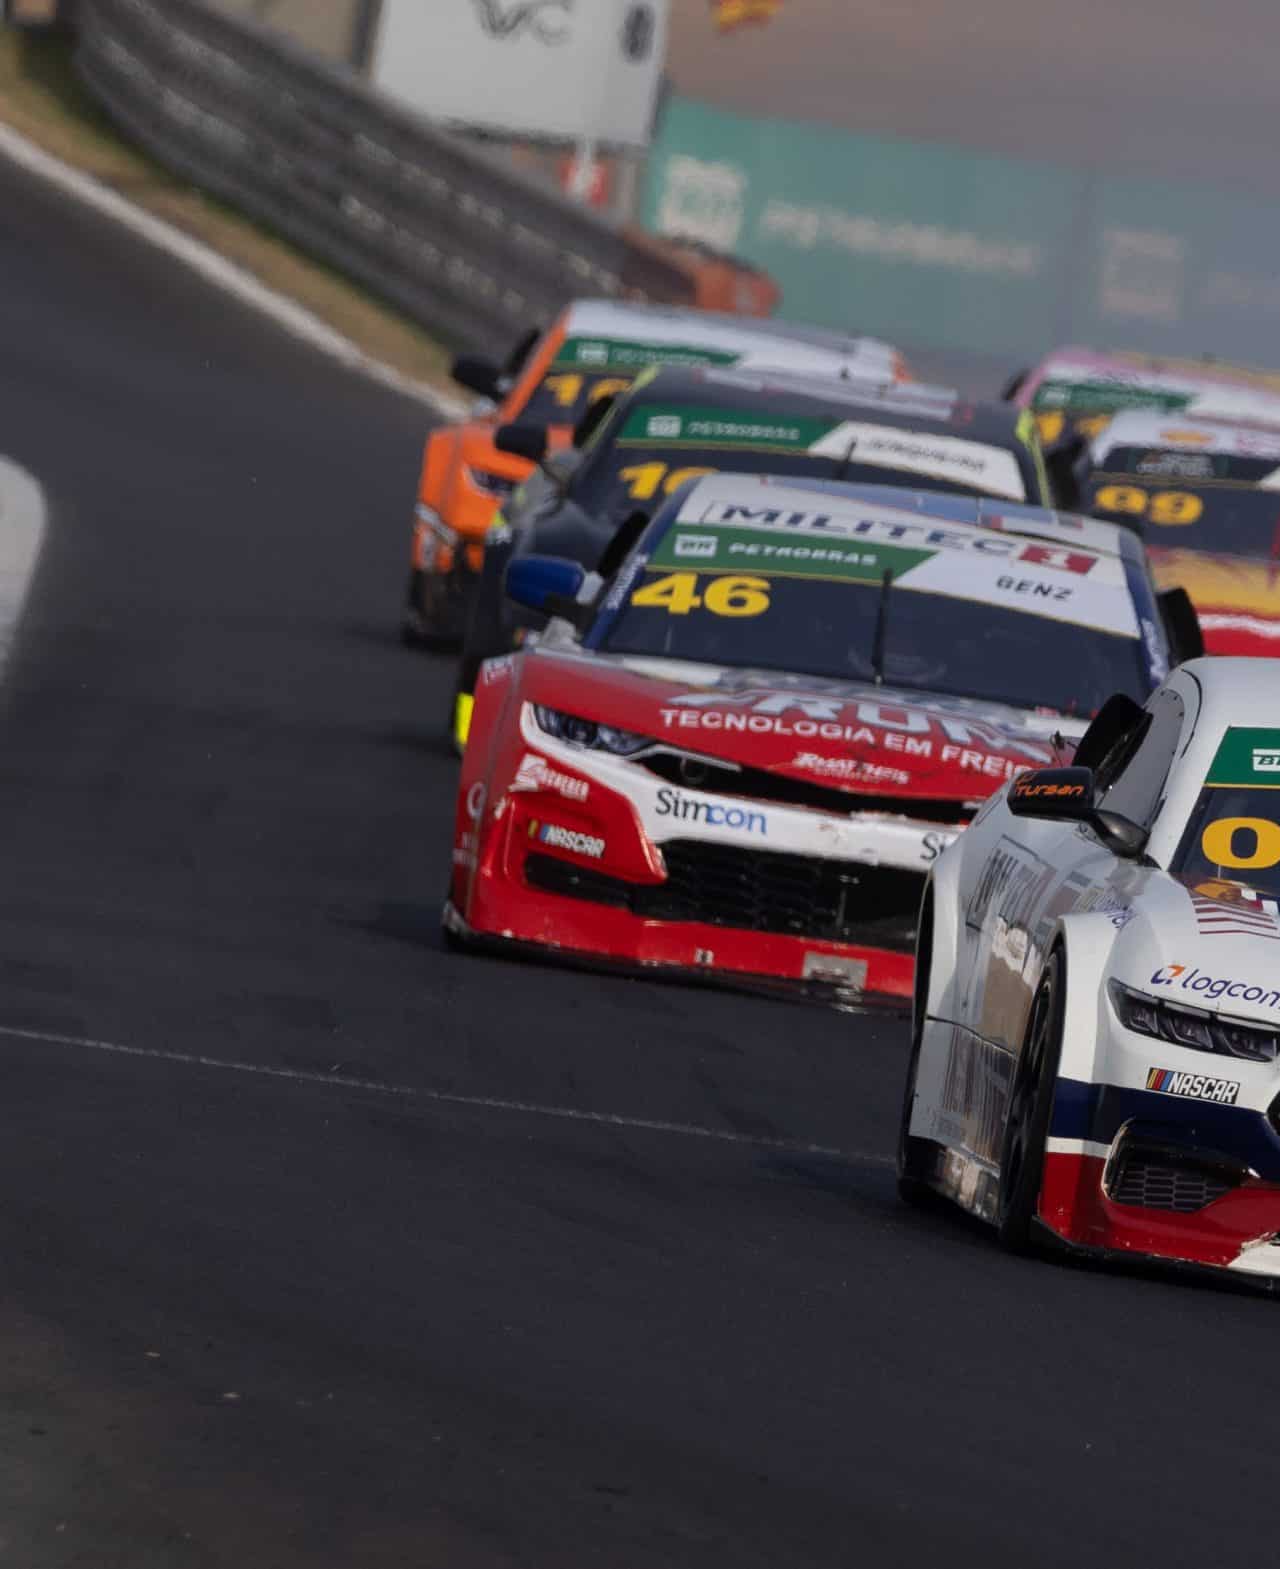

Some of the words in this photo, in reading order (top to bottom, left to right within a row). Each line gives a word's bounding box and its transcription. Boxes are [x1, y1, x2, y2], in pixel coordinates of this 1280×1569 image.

[720, 503, 1016, 556] MILITEC
[728, 542, 878, 567] PETROBRAS
[631, 572, 771, 617] 46
[660, 708, 875, 745] TECNOLOGIA
[884, 734, 933, 757] EM
[655, 787, 769, 835] Simcon
[543, 823, 605, 859] NASCAR
[1167, 1071, 1240, 1104] NASCAR
